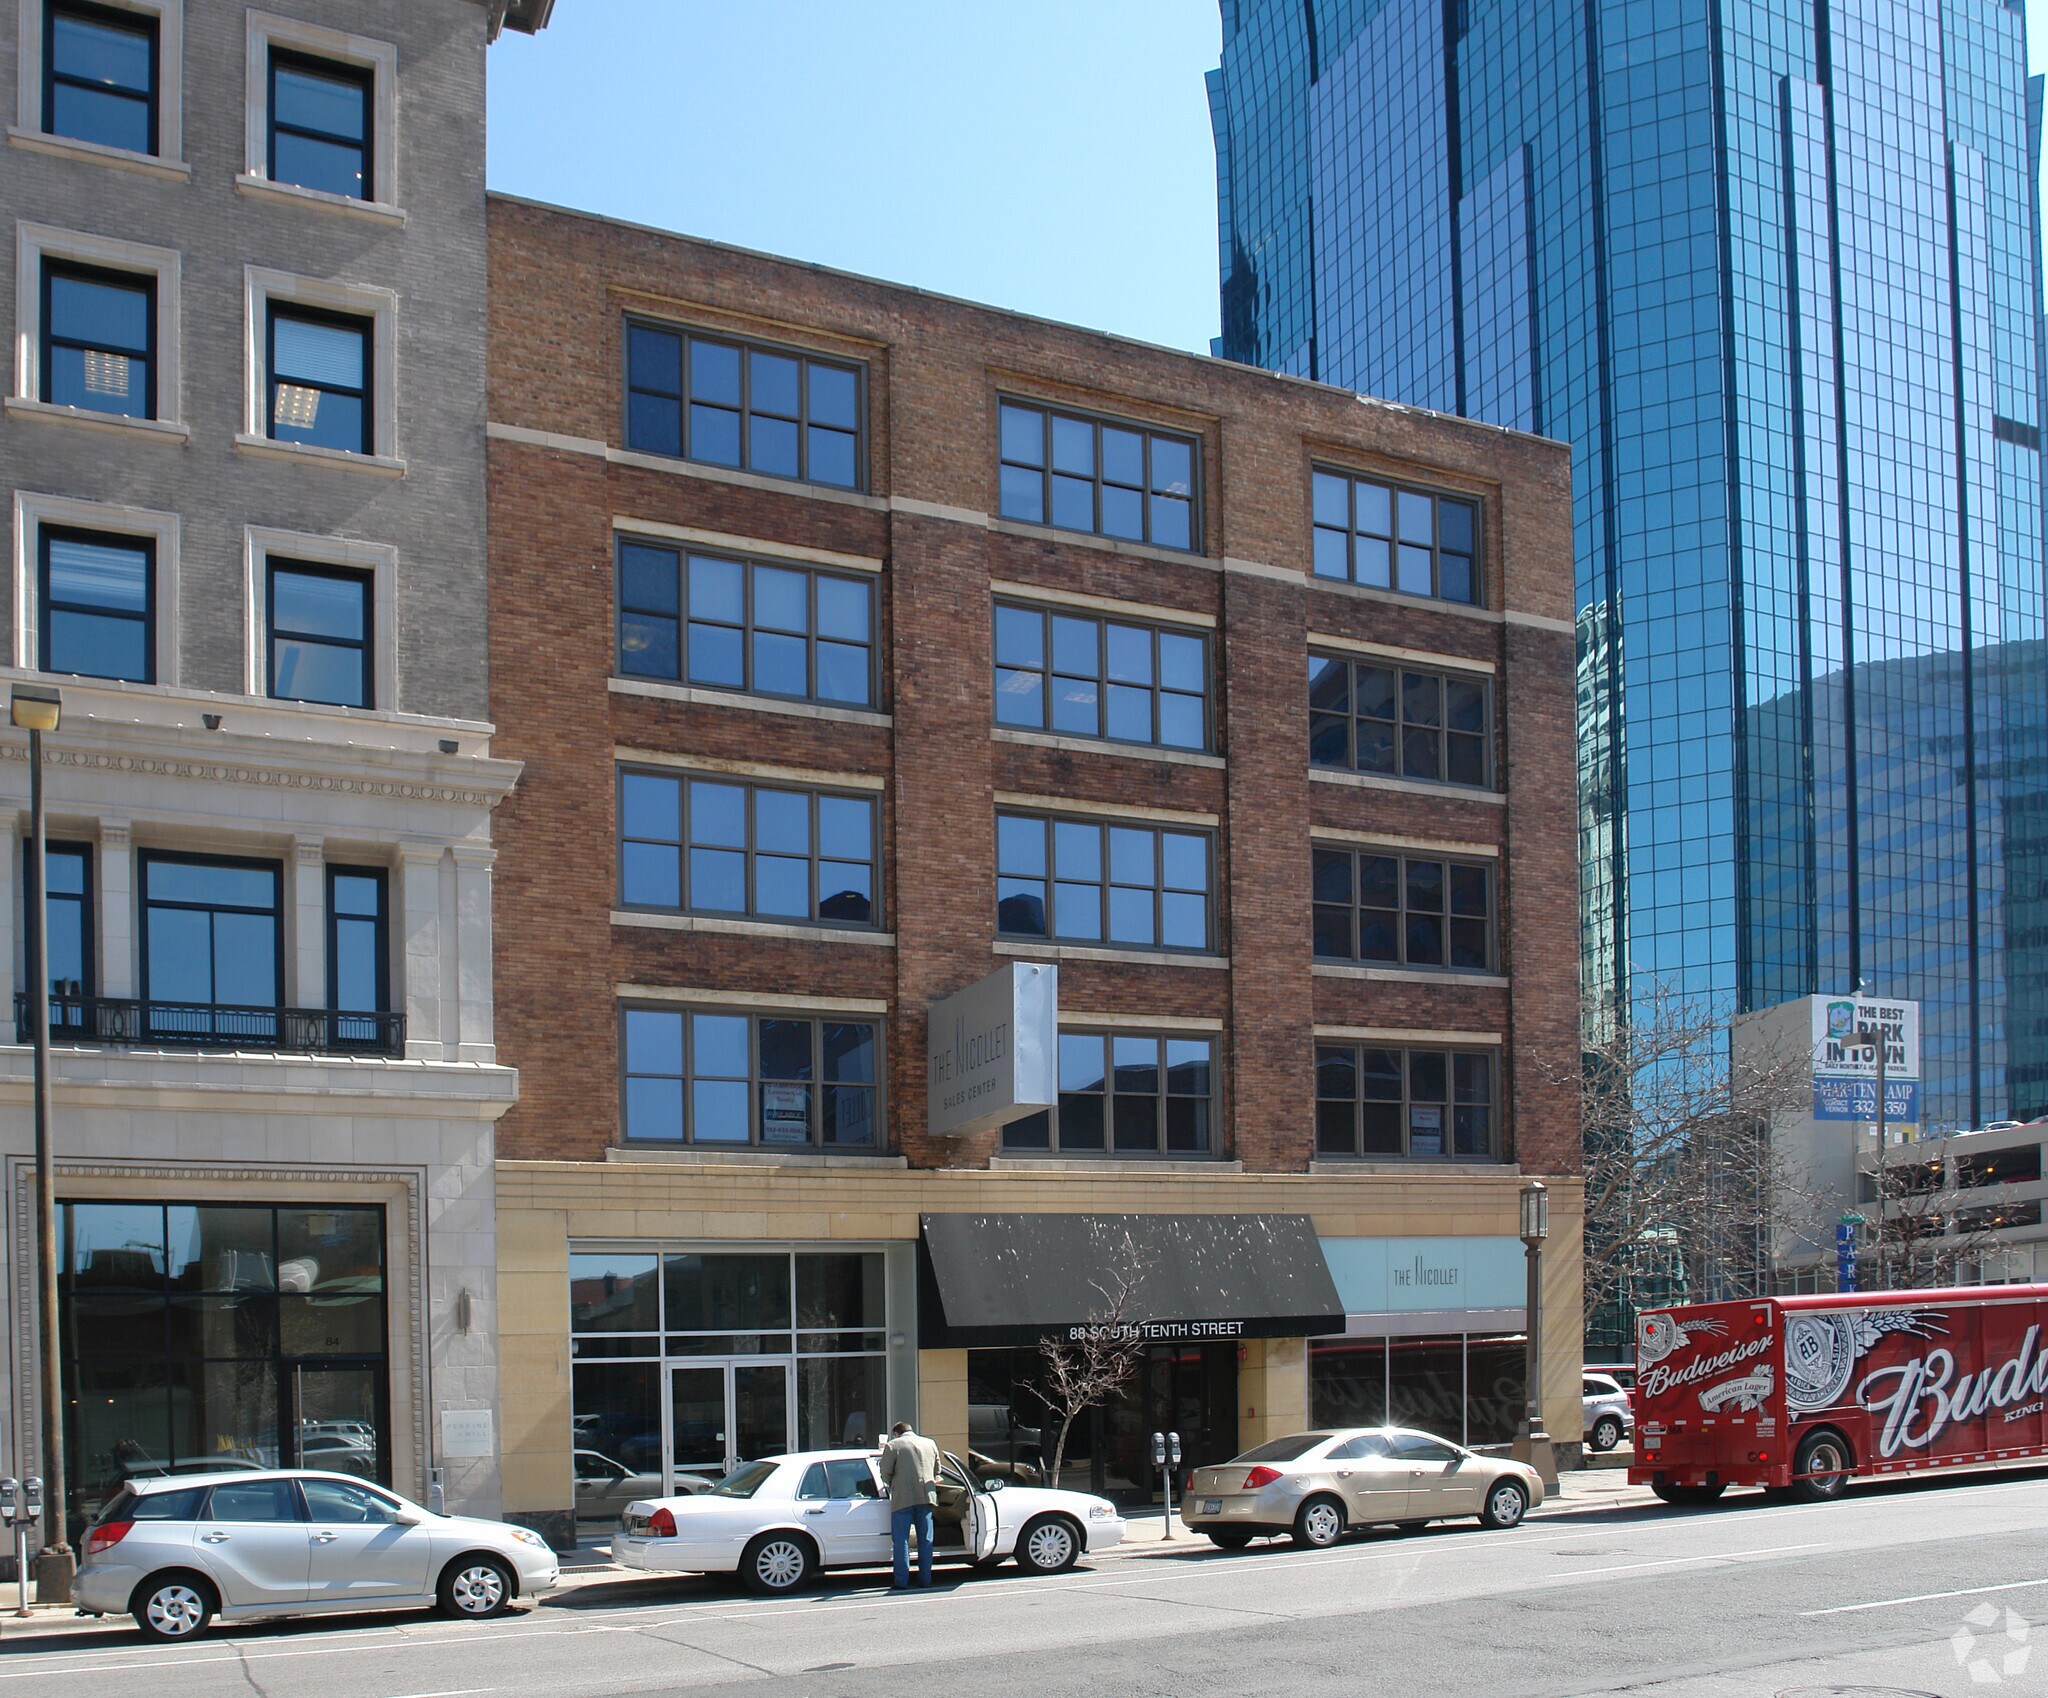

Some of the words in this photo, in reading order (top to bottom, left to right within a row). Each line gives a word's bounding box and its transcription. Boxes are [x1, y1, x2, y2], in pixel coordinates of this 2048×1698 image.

[1858, 1006, 1877, 1018] THE
[1879, 1007, 1904, 1020] BEST
[934, 1049, 951, 1086] THE
[956, 1014, 1007, 1077] NICOLLET
[1826, 1042, 1845, 1062] IN
[943, 1090, 965, 1110] SALES
[968, 1078, 997, 1101] CENTER
[1394, 1269, 1411, 1286] THE
[1415, 1255, 1459, 1286] NICOLLET
[325, 1336, 339, 1346] 84
[1069, 1327, 1086, 1340] 88
[1089, 1325, 1139, 1341] SOUTH
[1142, 1324, 1188, 1338] TENTH
[1191, 1321, 1244, 1336] STREET
[1799, 1335, 1819, 1361] AB
[1637, 1334, 1774, 1399] Budweiser
[1707, 1385, 1743, 1406] American
[1744, 1381, 1768, 1393] Lager
[2003, 1401, 2044, 1423] KING
